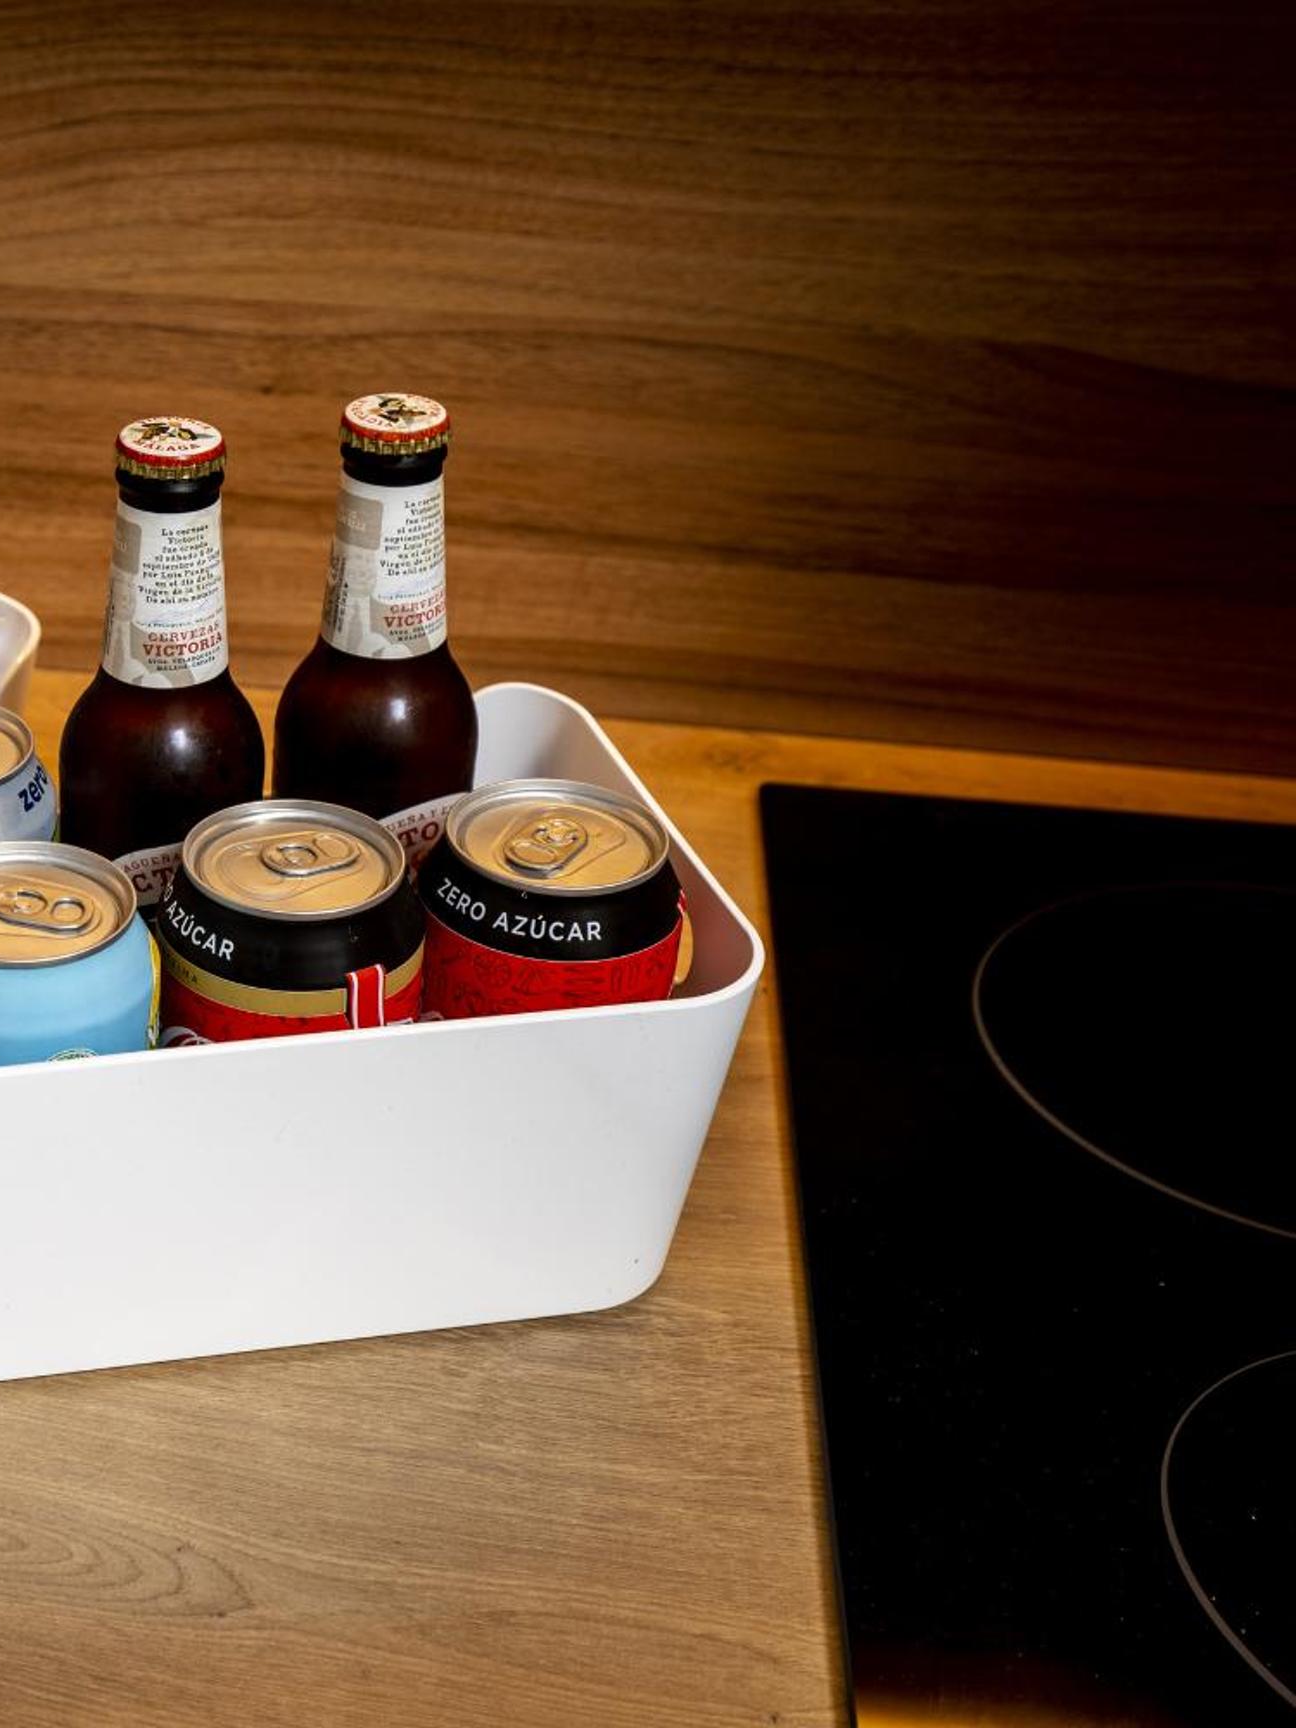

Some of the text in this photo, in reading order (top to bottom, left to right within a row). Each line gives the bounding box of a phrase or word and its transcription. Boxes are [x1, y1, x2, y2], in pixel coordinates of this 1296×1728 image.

[142, 632, 222, 657] VICTORIA
[148, 621, 220, 643] CERVEZAS
[165, 900, 235, 961] AZÚCAR
[437, 878, 603, 942] ZERO AZÚCAR
